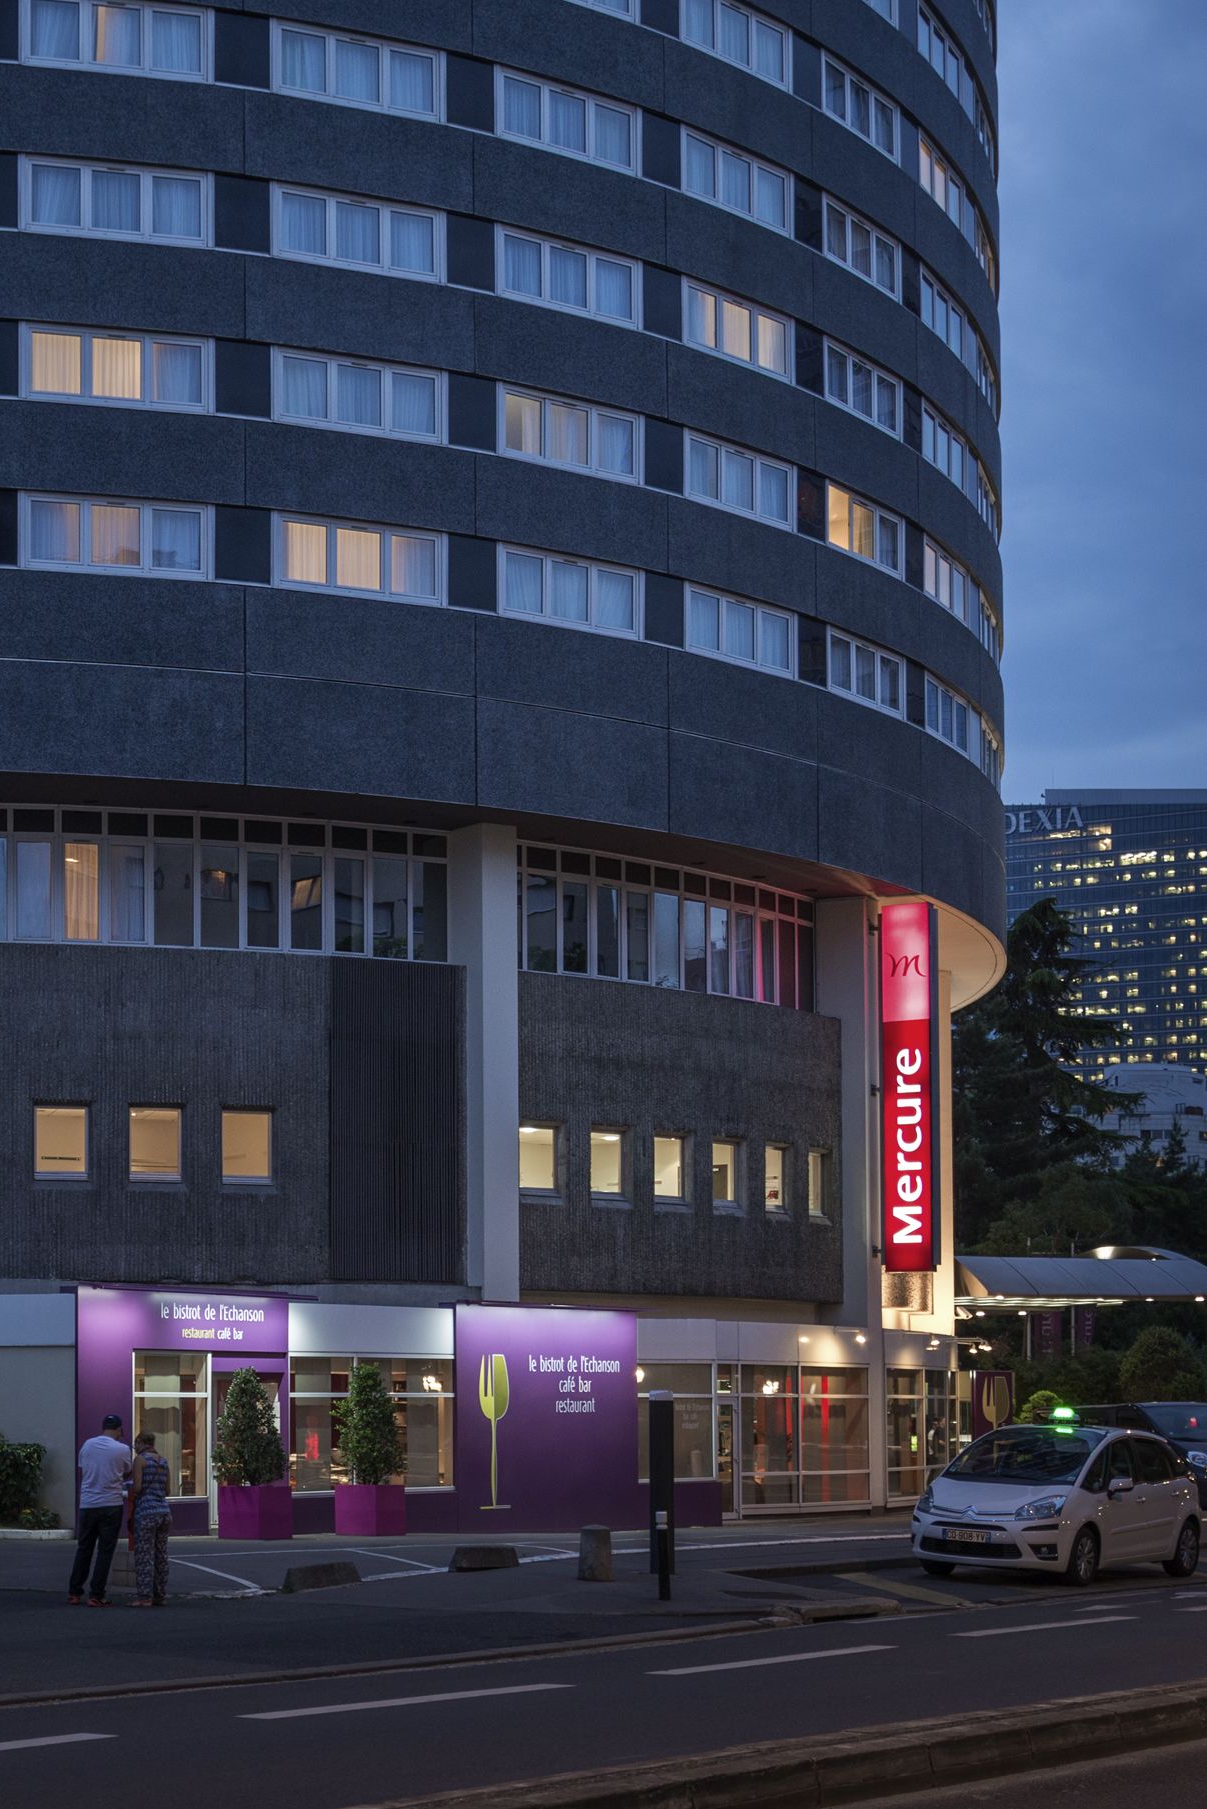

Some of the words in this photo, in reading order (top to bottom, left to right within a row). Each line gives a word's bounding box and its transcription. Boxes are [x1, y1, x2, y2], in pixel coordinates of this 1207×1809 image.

[1003, 806, 1084, 835] DEXIA
[892, 1048, 923, 1245] Mercure
[160, 1302, 170, 1319] le
[173, 1302, 201, 1320] bistrot
[204, 1303, 216, 1321] de
[181, 1327, 215, 1339] restaurant
[217, 1327, 231, 1340] café
[233, 1327, 244, 1340] bar
[528, 1354, 537, 1372] le
[539, 1354, 564, 1372] bistrot
[567, 1355, 578, 1373] de
[559, 1375, 576, 1393] café
[578, 1375, 592, 1393] bar
[555, 1397, 596, 1413] restaurant
